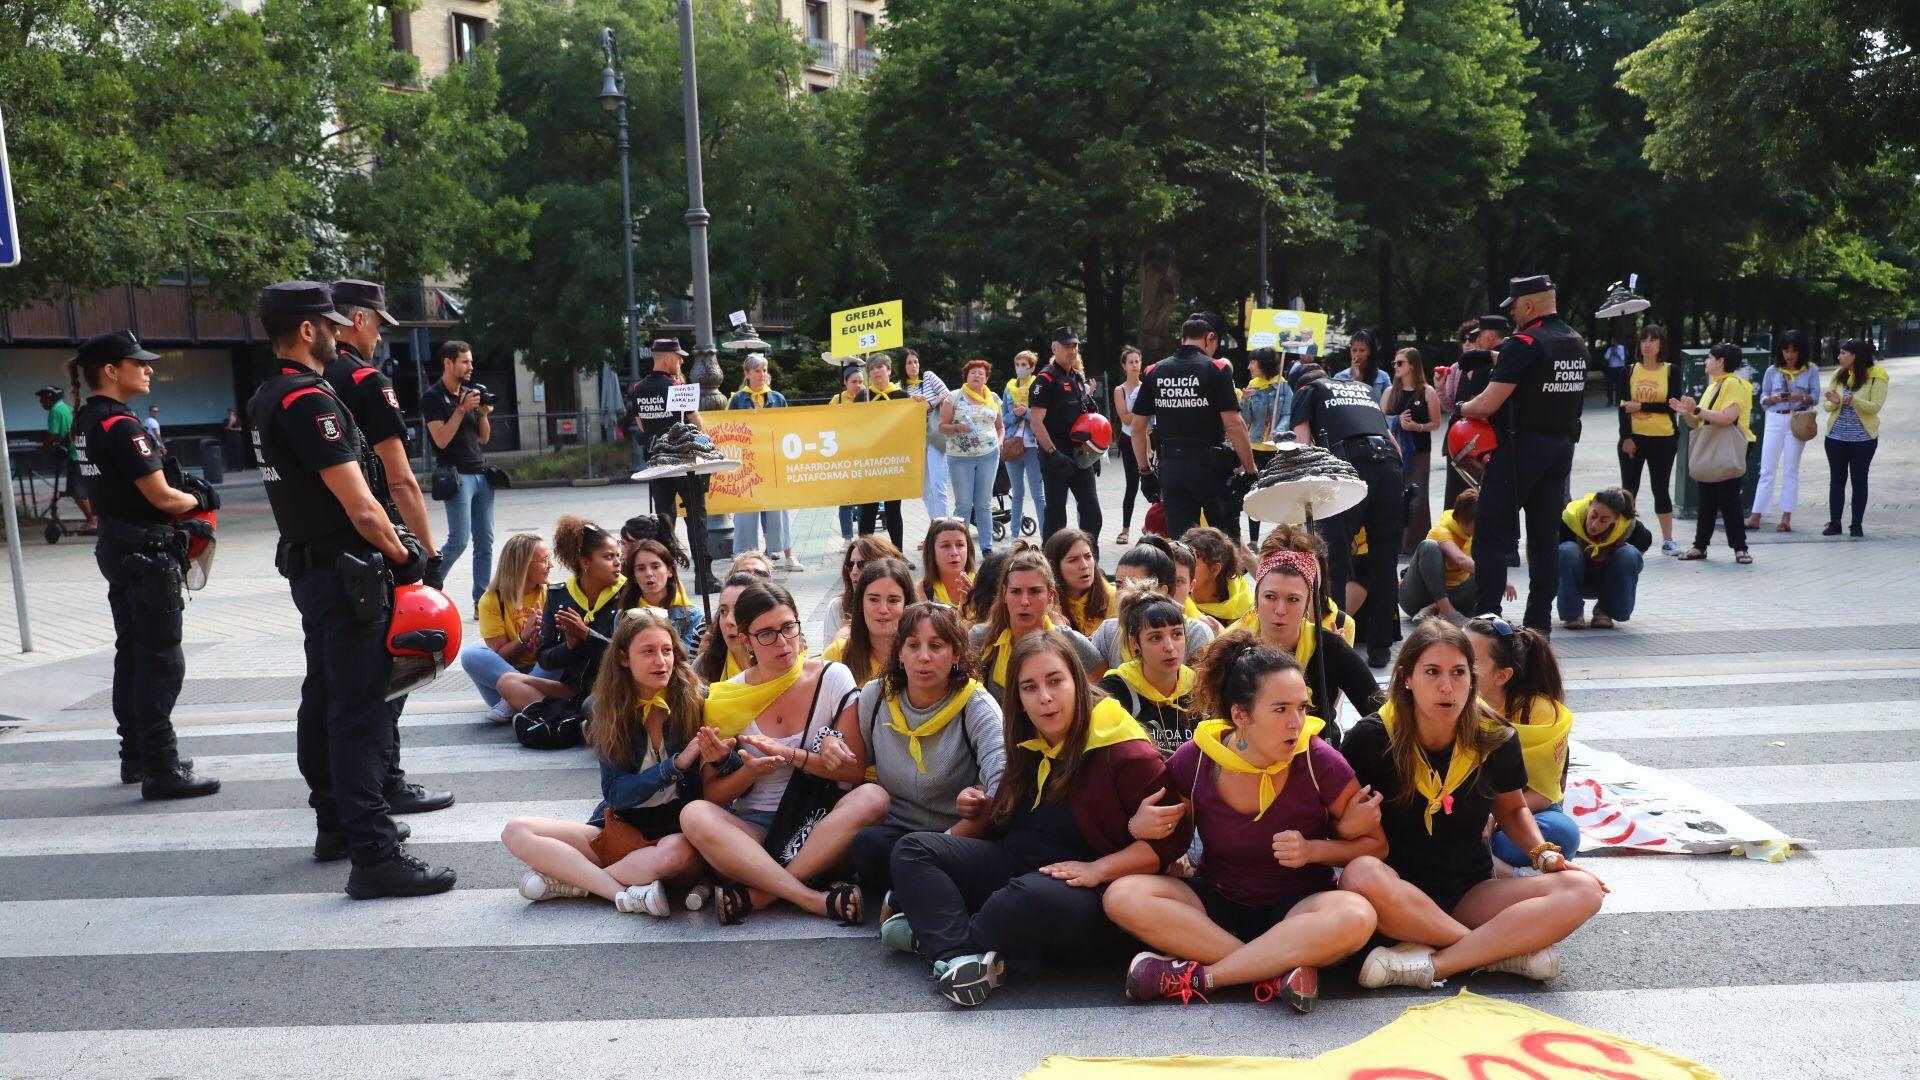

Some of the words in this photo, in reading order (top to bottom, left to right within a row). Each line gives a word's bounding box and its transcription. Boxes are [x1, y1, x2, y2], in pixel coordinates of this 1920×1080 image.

[845, 307, 884, 322] GREBA
[841, 318, 892, 335] EGUNAK
[1553, 357, 1587, 371] POLICÍA
[1157, 374, 1200, 387] POLICÍA
[1555, 370, 1584, 381] FORAL
[1160, 388, 1198, 398] FORAL
[1324, 382, 1371, 393] POLICÍA
[637, 395, 665, 405] POLICÍA
[1332, 389, 1371, 400] FORAL
[640, 404, 665, 412] FORAL
[1155, 397, 1209, 408] FORUZAINGOA
[1324, 397, 1382, 412] FORUZAINGOA
[782, 431, 838, 460] 0-3
[786, 460, 852, 473] NAFARROAKO
[854, 455, 913, 469] PLATAFORMA
[786, 471, 849, 483] PLATAFORMA
[851, 469, 863, 479] DE
[864, 465, 906, 477] NAVARRA
